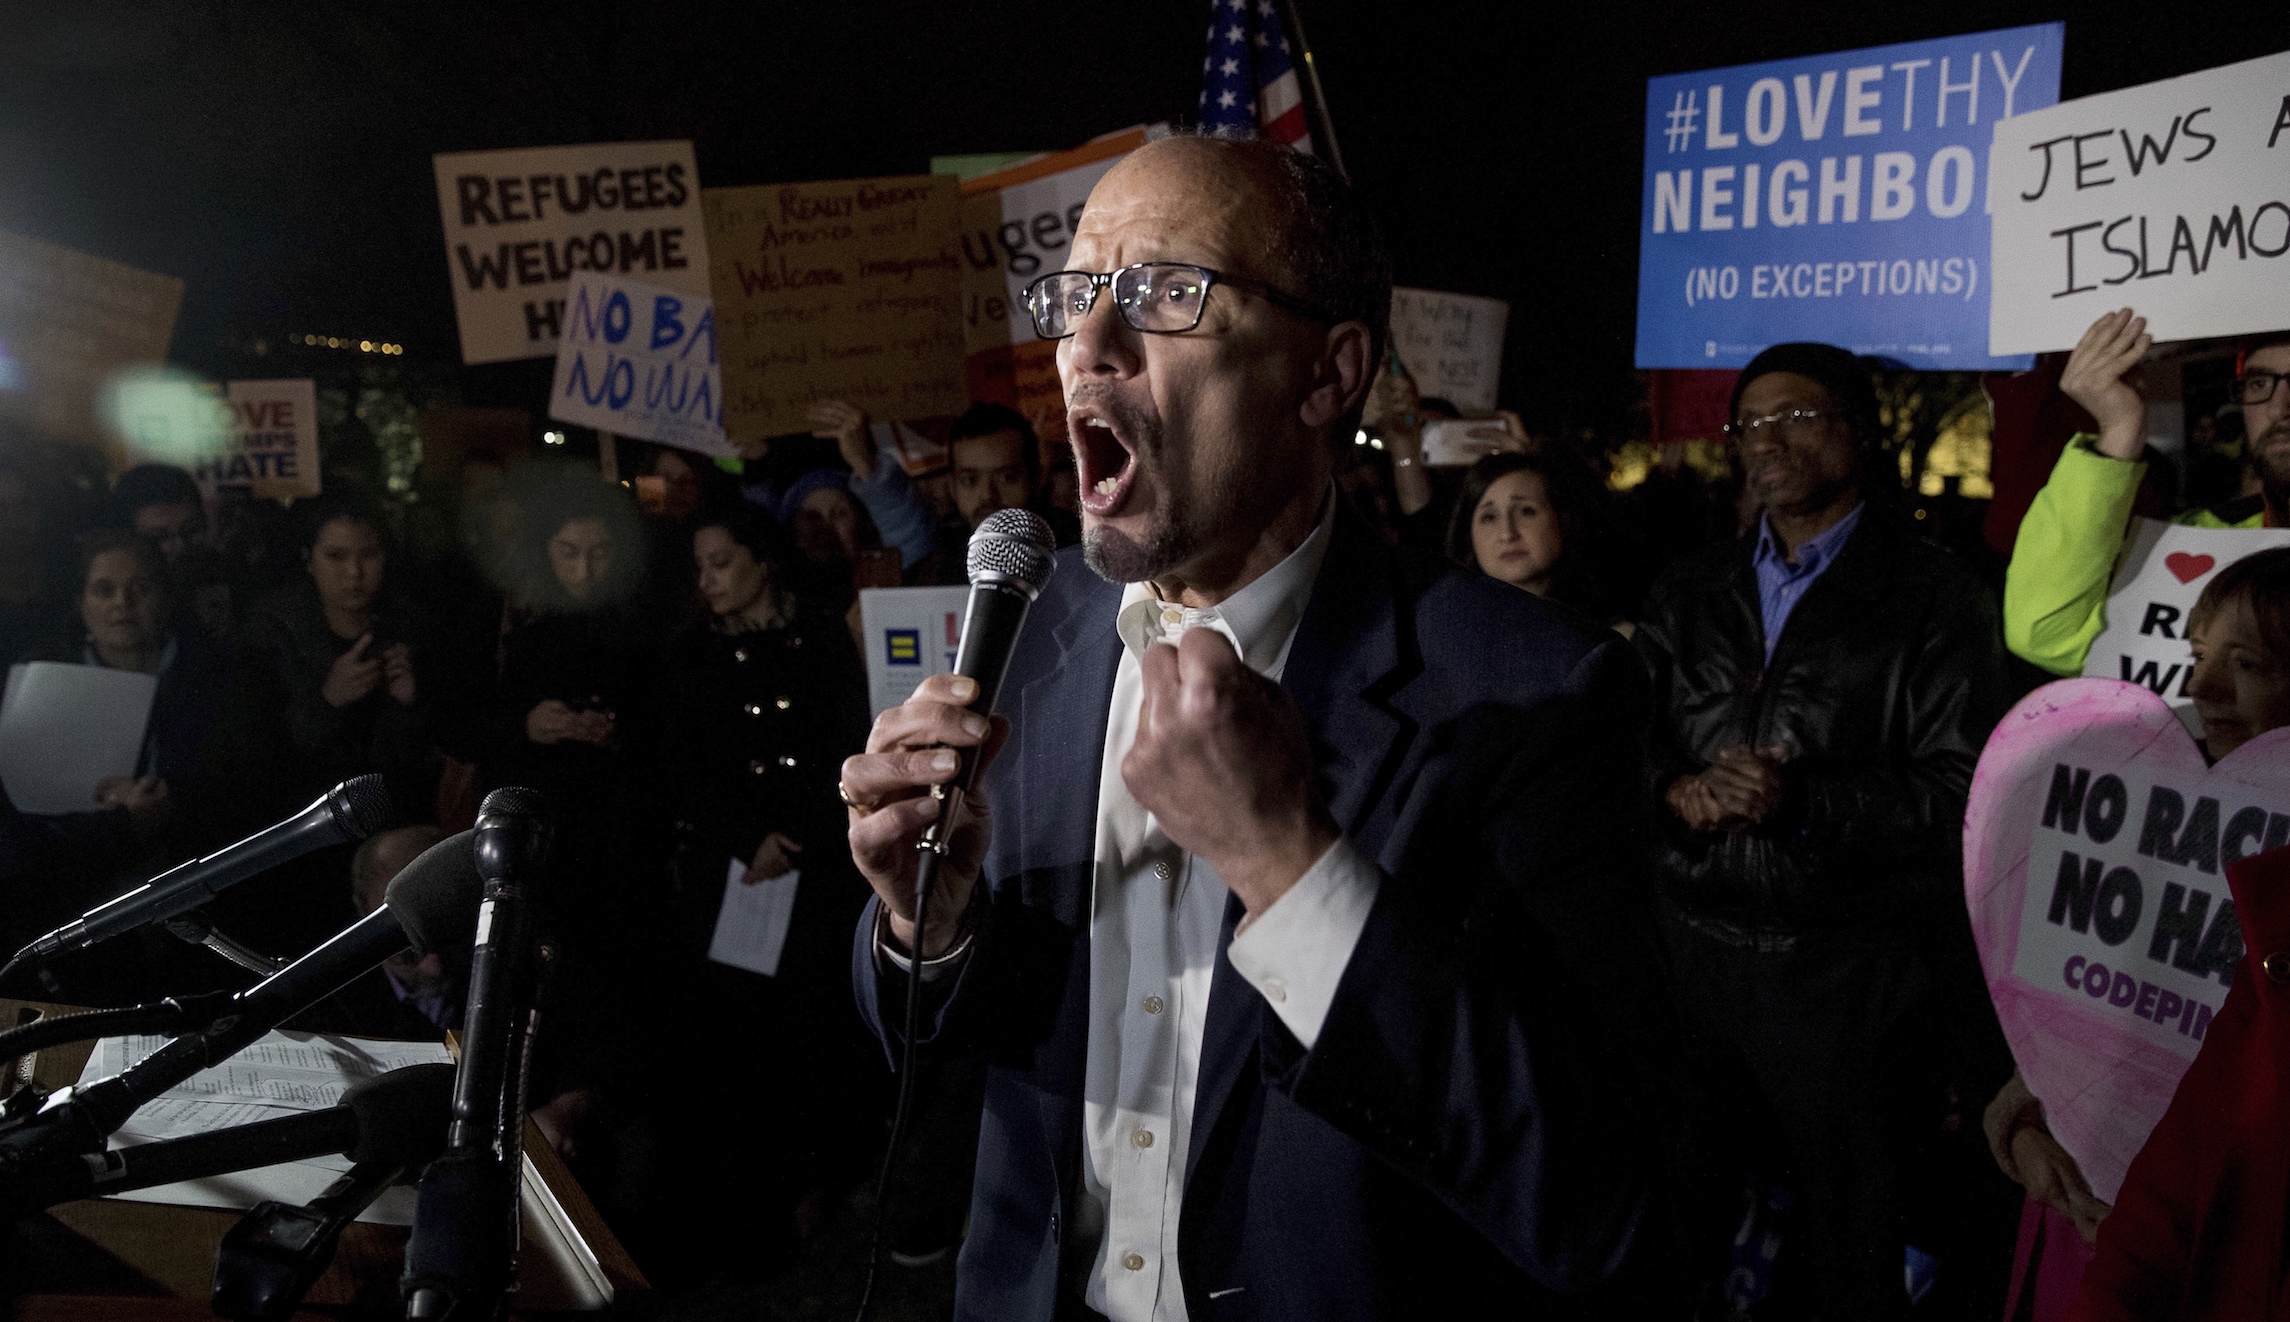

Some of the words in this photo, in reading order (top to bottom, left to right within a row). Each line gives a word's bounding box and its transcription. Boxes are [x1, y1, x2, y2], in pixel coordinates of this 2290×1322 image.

[2021, 106, 2216, 201] JEWS
[457, 163, 688, 226] REFUGEES
[1652, 145, 1990, 234] NEIGHBO
[457, 228, 688, 291] WELCOME
[733, 254, 844, 297] Welcome
[1685, 265, 1739, 307] (NO
[1751, 257, 1979, 302] EXCEPTIONS)
[2051, 202, 2290, 298] ISLAMO
[570, 285, 632, 343] NO
[566, 351, 635, 410] NO
[646, 361, 724, 428] WA
[2140, 602, 2190, 640] R
[2041, 763, 2127, 844] NO
[2047, 850, 2143, 946] NO
[2148, 881, 2244, 989] HA
